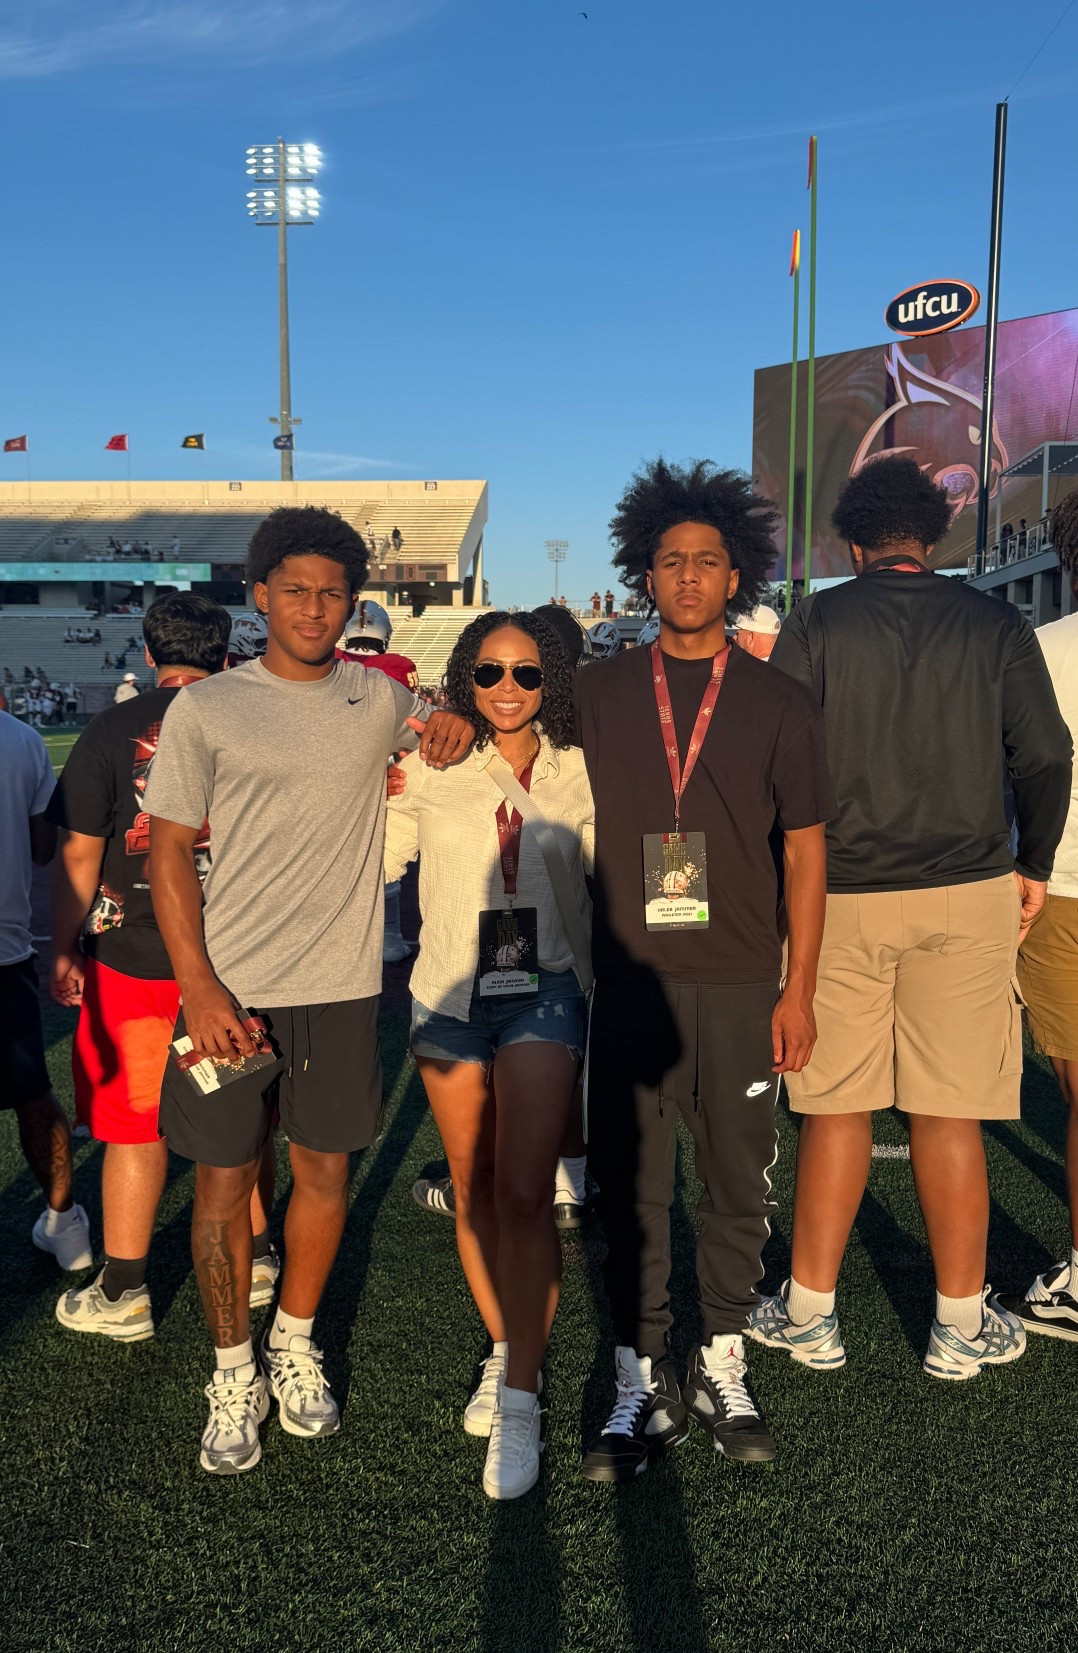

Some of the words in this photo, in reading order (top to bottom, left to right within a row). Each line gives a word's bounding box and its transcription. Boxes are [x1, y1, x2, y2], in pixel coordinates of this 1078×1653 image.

[898, 291, 958, 323] ufcu
[658, 705, 666, 724] STATE
[208, 1222, 235, 1347] JAMMER
